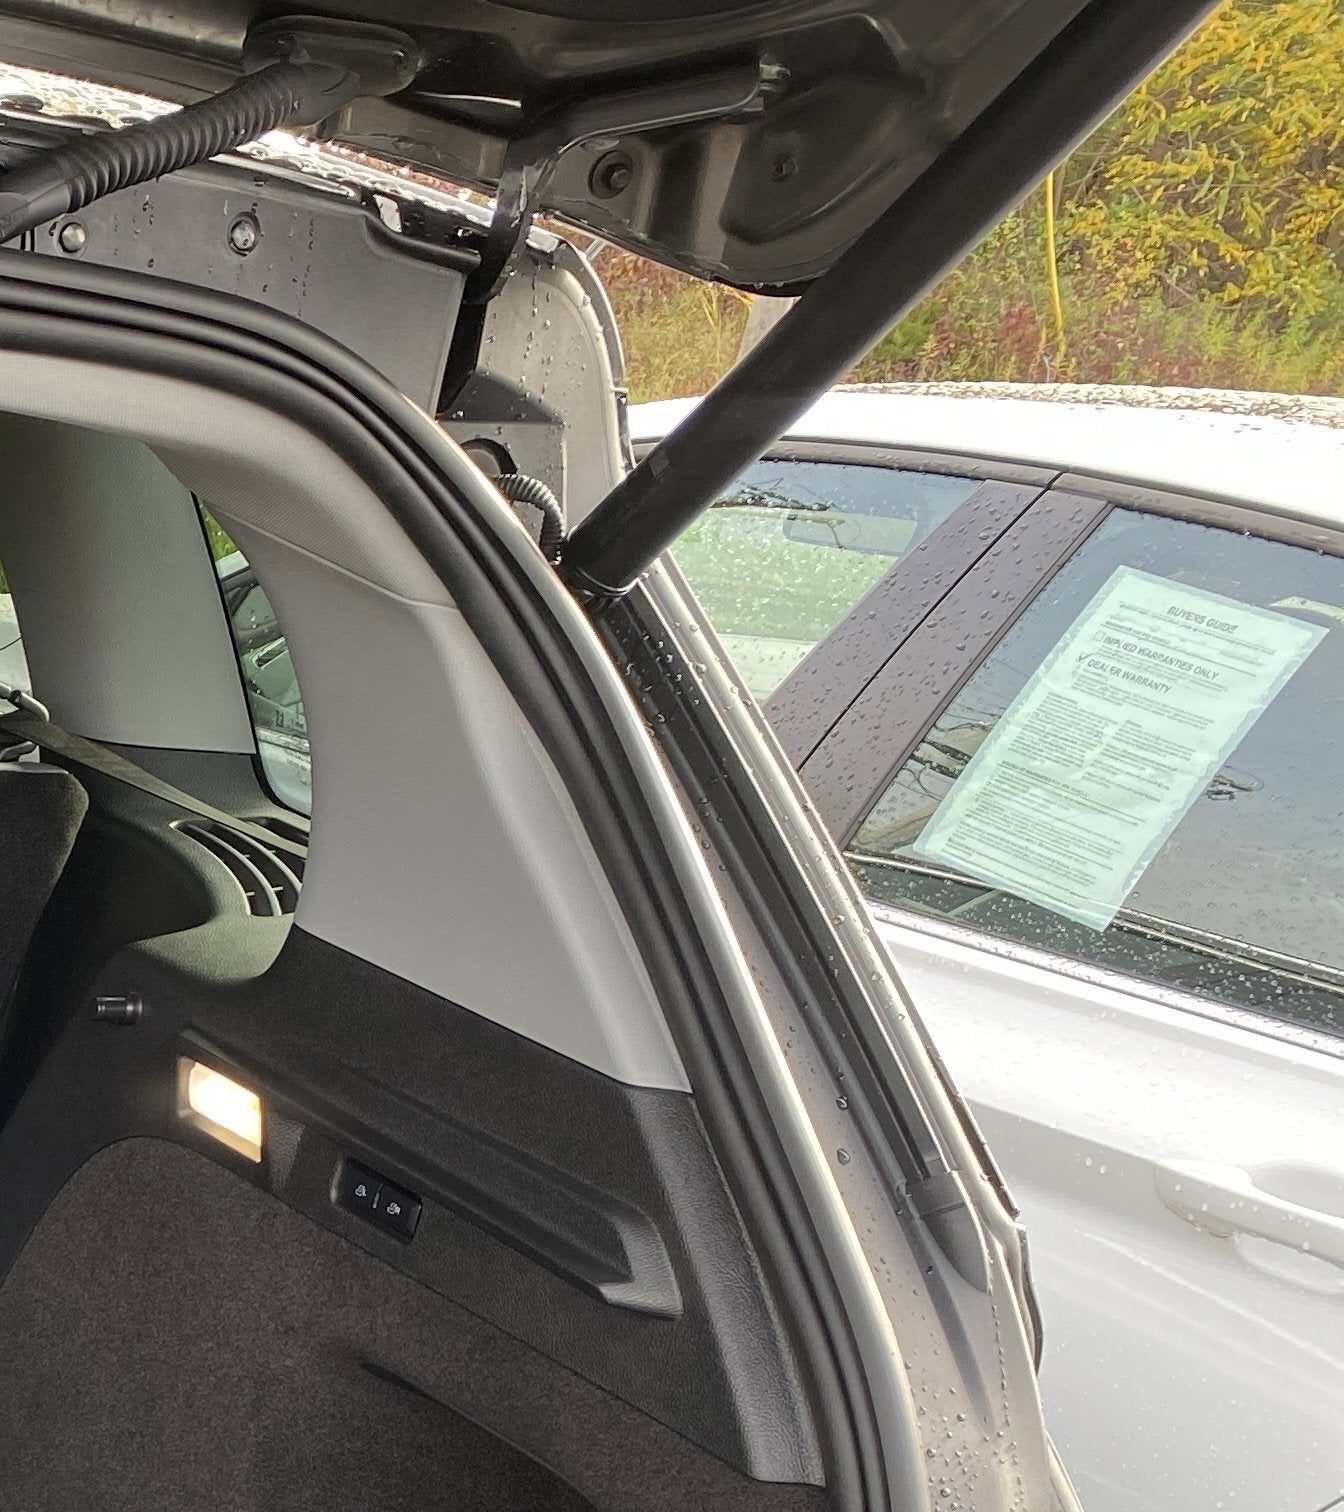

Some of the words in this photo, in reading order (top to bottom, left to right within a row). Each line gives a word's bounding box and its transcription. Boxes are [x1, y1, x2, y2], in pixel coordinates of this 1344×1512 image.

[1167, 606, 1206, 625] BUYERS
[1087, 658, 1122, 677] DEALER
[1122, 671, 1172, 694] WARRANTY
[1103, 636, 1137, 653] IMPLIED
[1137, 647, 1193, 672] WARRANTIES
[1193, 665, 1220, 681] ONLY
